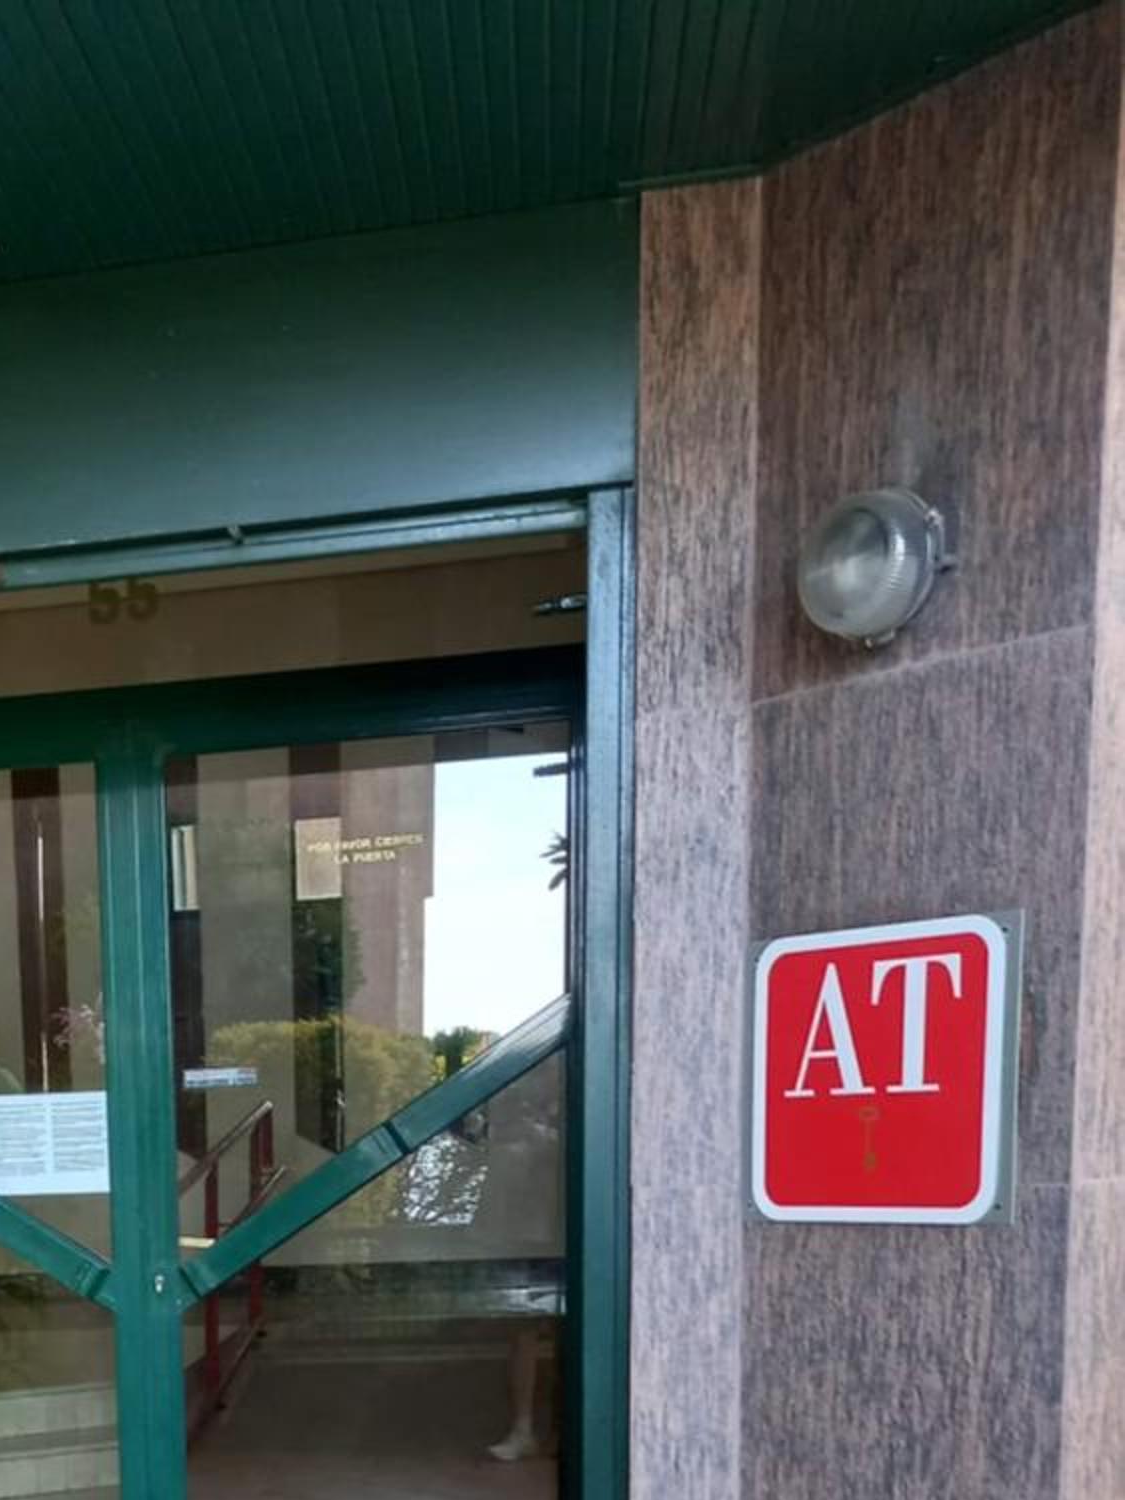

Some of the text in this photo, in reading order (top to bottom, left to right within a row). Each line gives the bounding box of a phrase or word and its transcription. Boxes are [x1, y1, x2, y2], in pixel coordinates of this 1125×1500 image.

[334, 837, 371, 850] FAVOR
[334, 850, 396, 864] LA PUERTA
[784, 952, 963, 1098] AT
